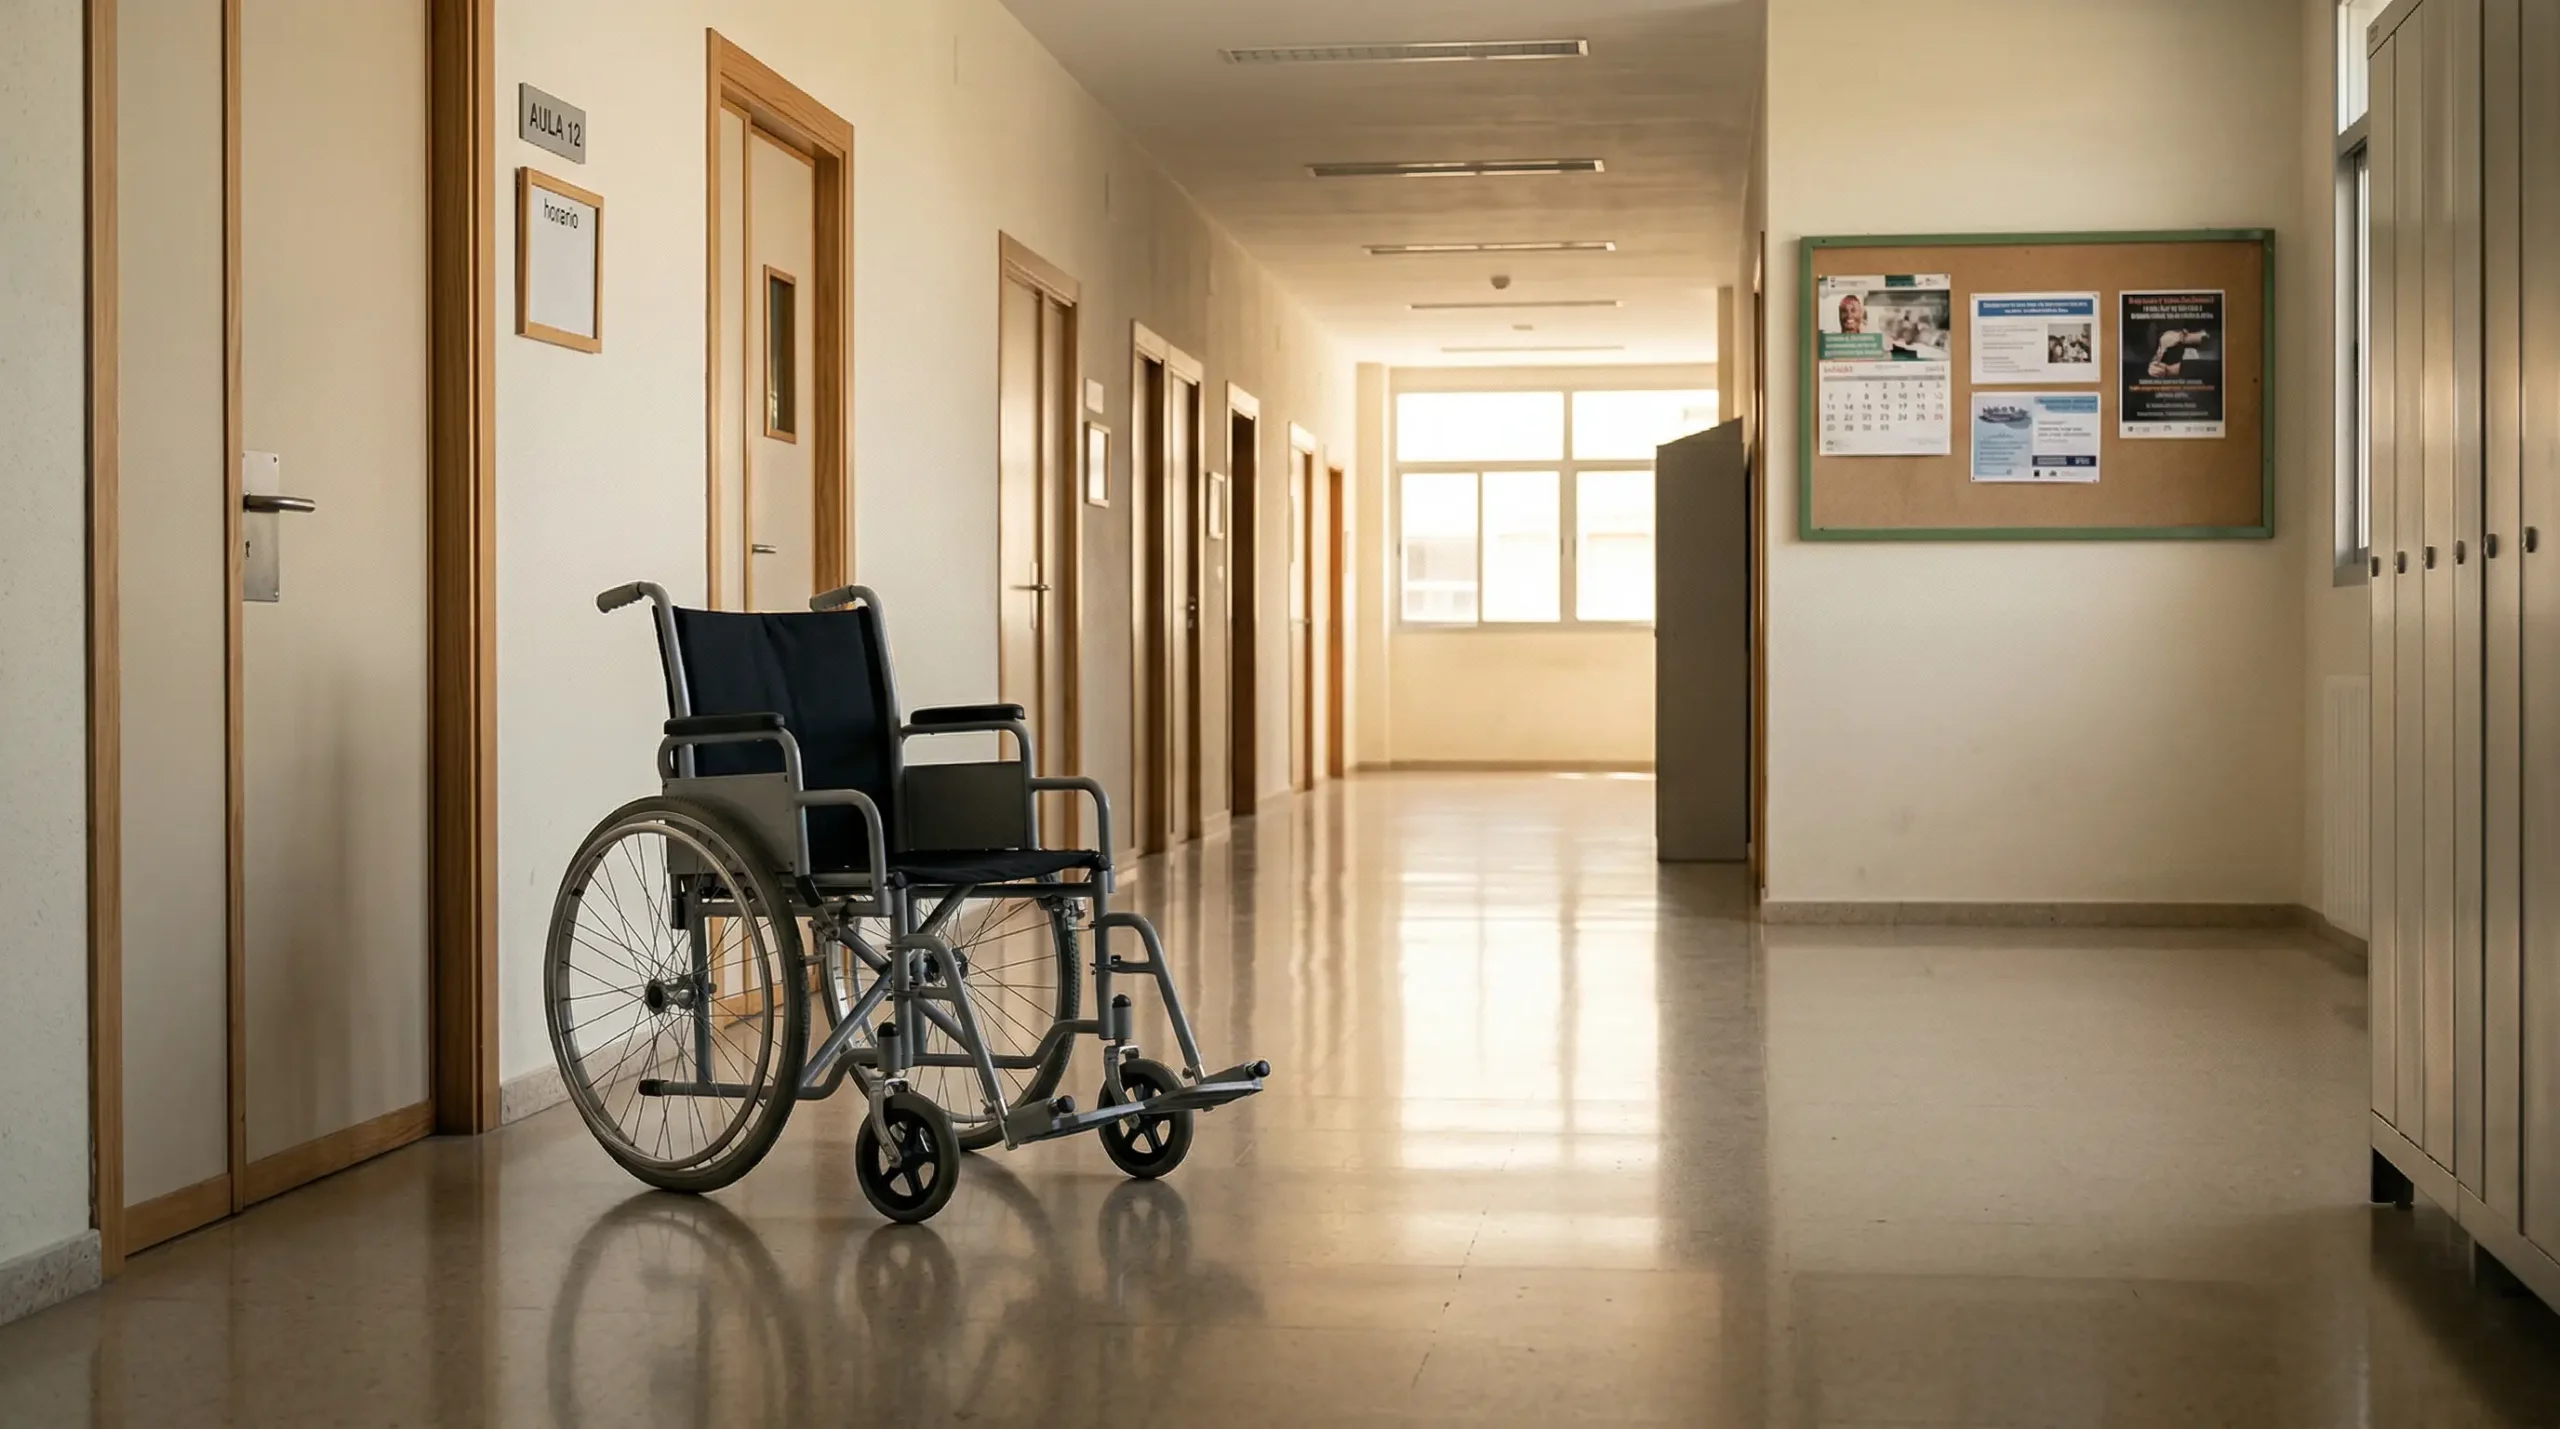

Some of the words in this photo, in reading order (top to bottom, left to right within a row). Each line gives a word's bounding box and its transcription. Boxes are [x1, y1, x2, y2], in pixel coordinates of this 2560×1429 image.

[530, 102, 564, 141] AULA
[567, 120, 581, 148] 12
[543, 198, 579, 229] horario
